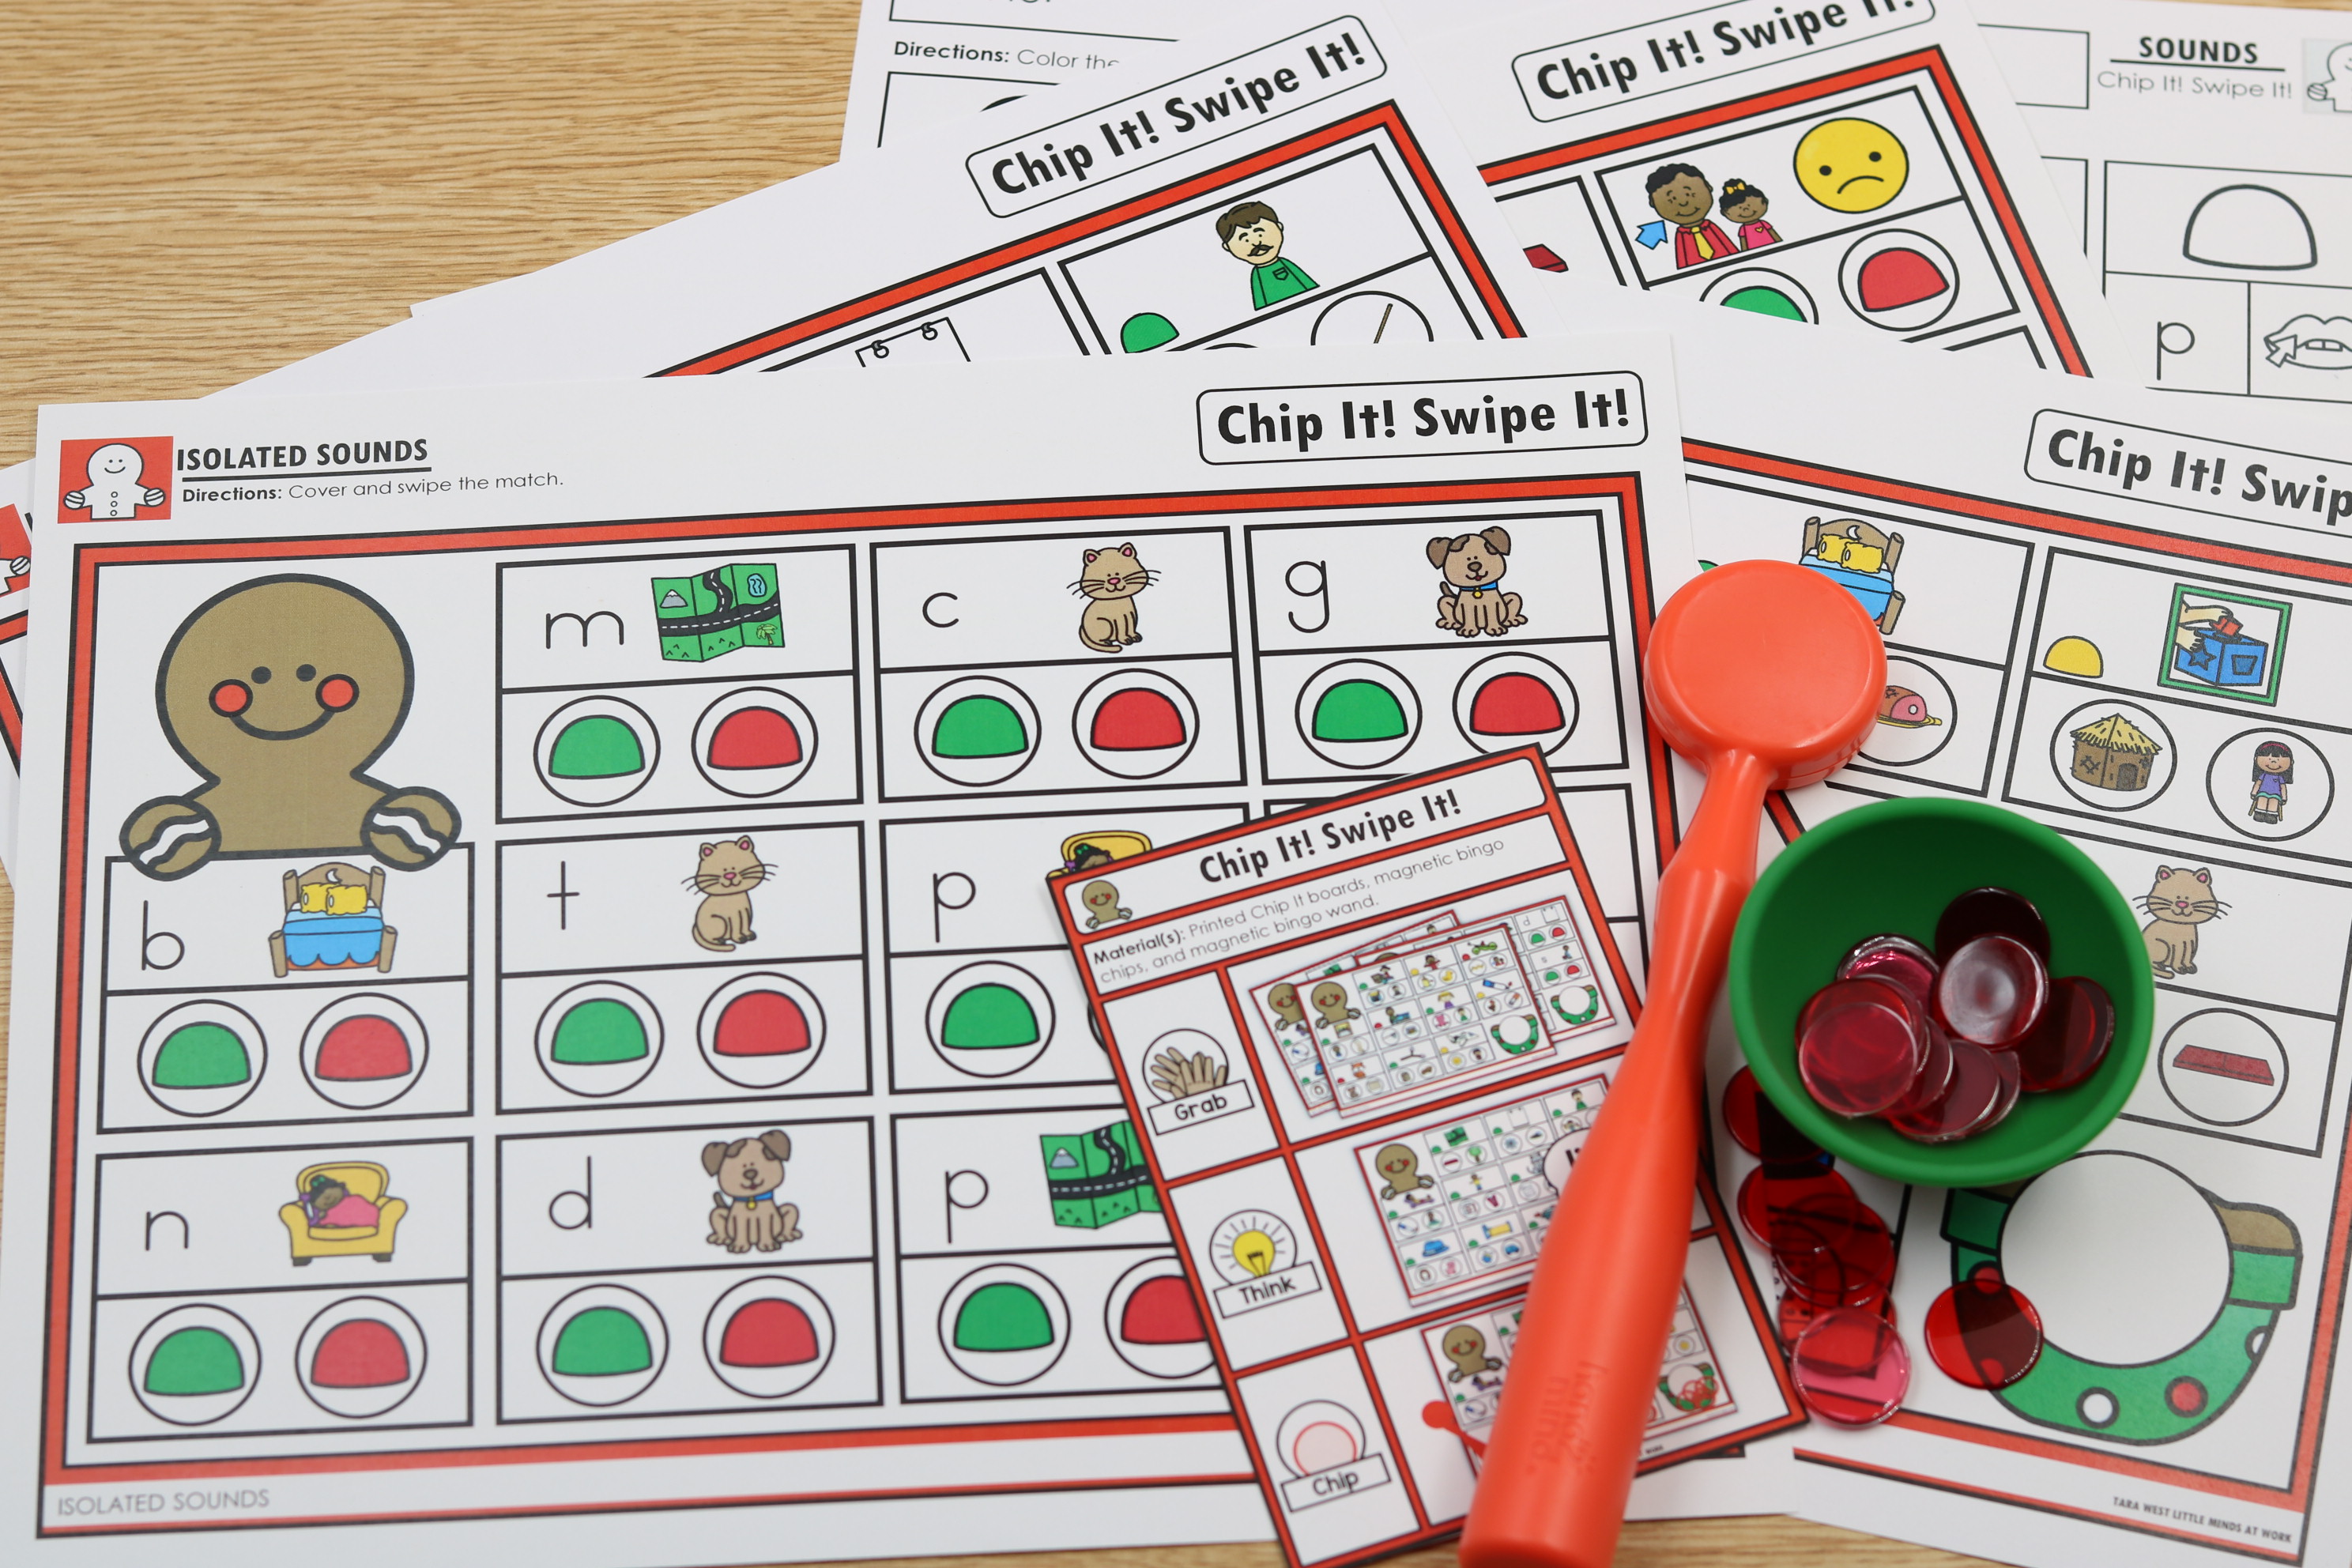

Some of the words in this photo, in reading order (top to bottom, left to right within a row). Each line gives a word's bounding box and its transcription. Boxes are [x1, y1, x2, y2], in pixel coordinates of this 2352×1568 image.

[894, 41, 1009, 62] Directions:
[1017, 49, 1080, 68] Color
[1536, 53, 1638, 100] Chip
[1647, 30, 1705, 73] It!
[1713, 4, 1848, 56] Swipe
[2139, 36, 2258, 63] SOUNDS
[992, 143, 1094, 194] Chip
[1099, 111, 1160, 157] It!
[1165, 67, 1300, 133] Swipe
[1306, 32, 1366, 79] It!
[2098, 71, 2154, 93] Chip
[2164, 75, 2182, 92] It!
[2192, 77, 2264, 99] Swipe
[2273, 82, 2292, 98] It!
[2157, 322, 2195, 380] p
[1218, 402, 1322, 452] Chip
[1342, 400, 1396, 439] It!
[1413, 395, 1555, 443] Swipe
[1574, 388, 1630, 428] It!
[177, 445, 307, 470] ISOLATED
[317, 439, 428, 466] SOUNDS
[2049, 429, 2151, 490] Chip
[2170, 450, 2226, 496] It!
[2241, 464, 2352, 526] Swip
[183, 486, 281, 502] Directions:
[288, 484, 347, 499] Cover
[353, 481, 391, 496] and
[398, 477, 451, 496] swipe
[458, 476, 489, 490] the
[496, 472, 564, 488] match.
[922, 592, 959, 628] c
[1285, 560, 1331, 632] g
[545, 611, 624, 649] m
[1200, 847, 1269, 883] Chip
[1276, 830, 1315, 862] It!
[1321, 808, 1415, 850] Swipe
[1421, 789, 1461, 821] It!
[547, 861, 579, 929] t
[933, 873, 975, 943] p
[1094, 929, 1185, 965] Material(s):
[1189, 910, 1246, 938] Printed
[1250, 900, 1290, 919] Chip
[1293, 894, 1304, 908] It
[1307, 878, 1370, 904] boards,
[1374, 854, 1453, 885] magnetic
[1456, 840, 1505, 861] bingo
[142, 900, 184, 971] b
[1101, 962, 1148, 983] chips,
[1152, 948, 1186, 968] and
[1191, 925, 1270, 958] magnetic
[1274, 910, 1322, 934] bingo
[1326, 894, 1379, 918] wand.
[1174, 1095, 1227, 1121] Grab
[548, 1155, 592, 1230] d
[944, 1170, 988, 1243] p
[145, 1211, 189, 1250] n
[1239, 1277, 1297, 1305] Think
[58, 1493, 165, 1516] ISOLATED
[173, 1489, 270, 1511] SOUNDS
[1312, 1470, 1359, 1498] Chip
[2113, 1496, 2139, 1510] TARA
[2143, 1502, 2170, 1517] WEST
[2173, 1509, 2205, 1525] LITTLE
[2207, 1517, 2241, 1532] MINDS
[2245, 1525, 2259, 1536] AT
[2262, 1528, 2292, 1543] WORK
